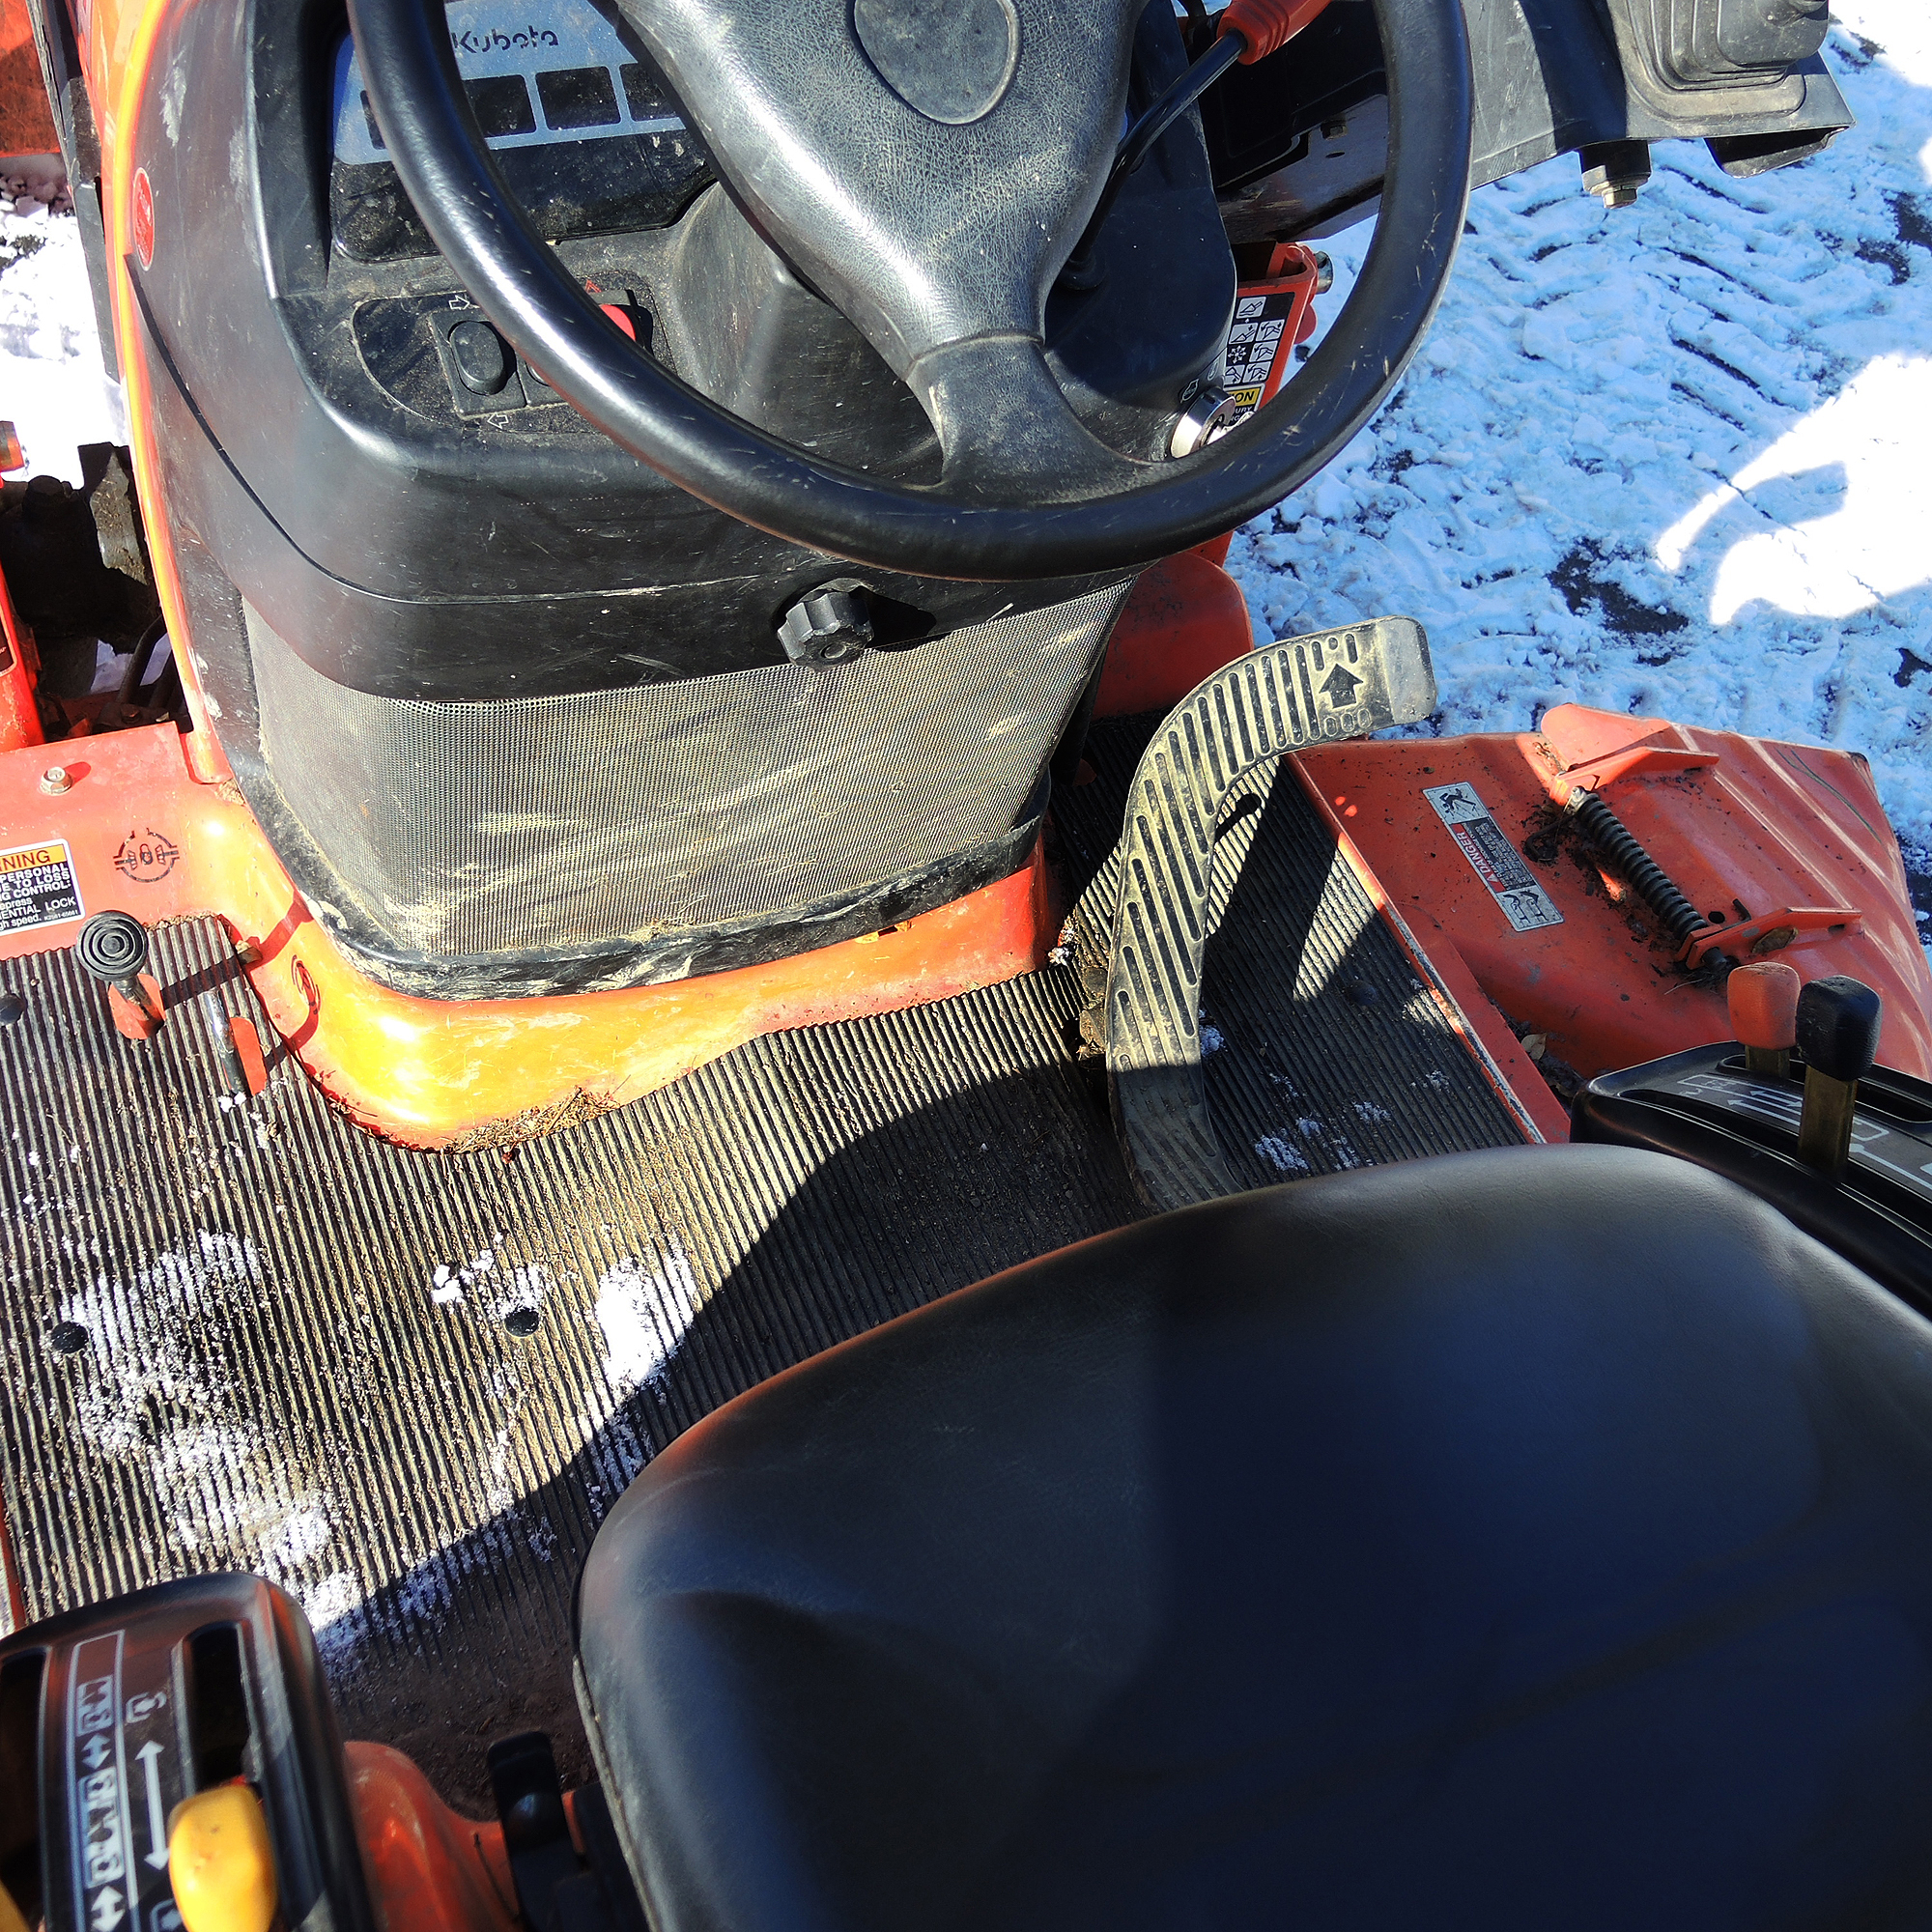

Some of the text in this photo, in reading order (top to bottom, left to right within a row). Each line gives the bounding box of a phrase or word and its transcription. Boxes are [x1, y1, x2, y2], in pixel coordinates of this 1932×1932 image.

[451, 25, 559, 53] Kubota
[0, 850, 50, 871] NING
[1456, 832, 1491, 874] DANGER
[0, 863, 69, 883] PERSONAL
[14, 879, 32, 889] TO
[36, 871, 71, 885] LOSS
[13, 880, 71, 898] CONTROL:
[0, 896, 76, 921] ENTIAL LOCK
[11, 914, 43, 927] speed.
